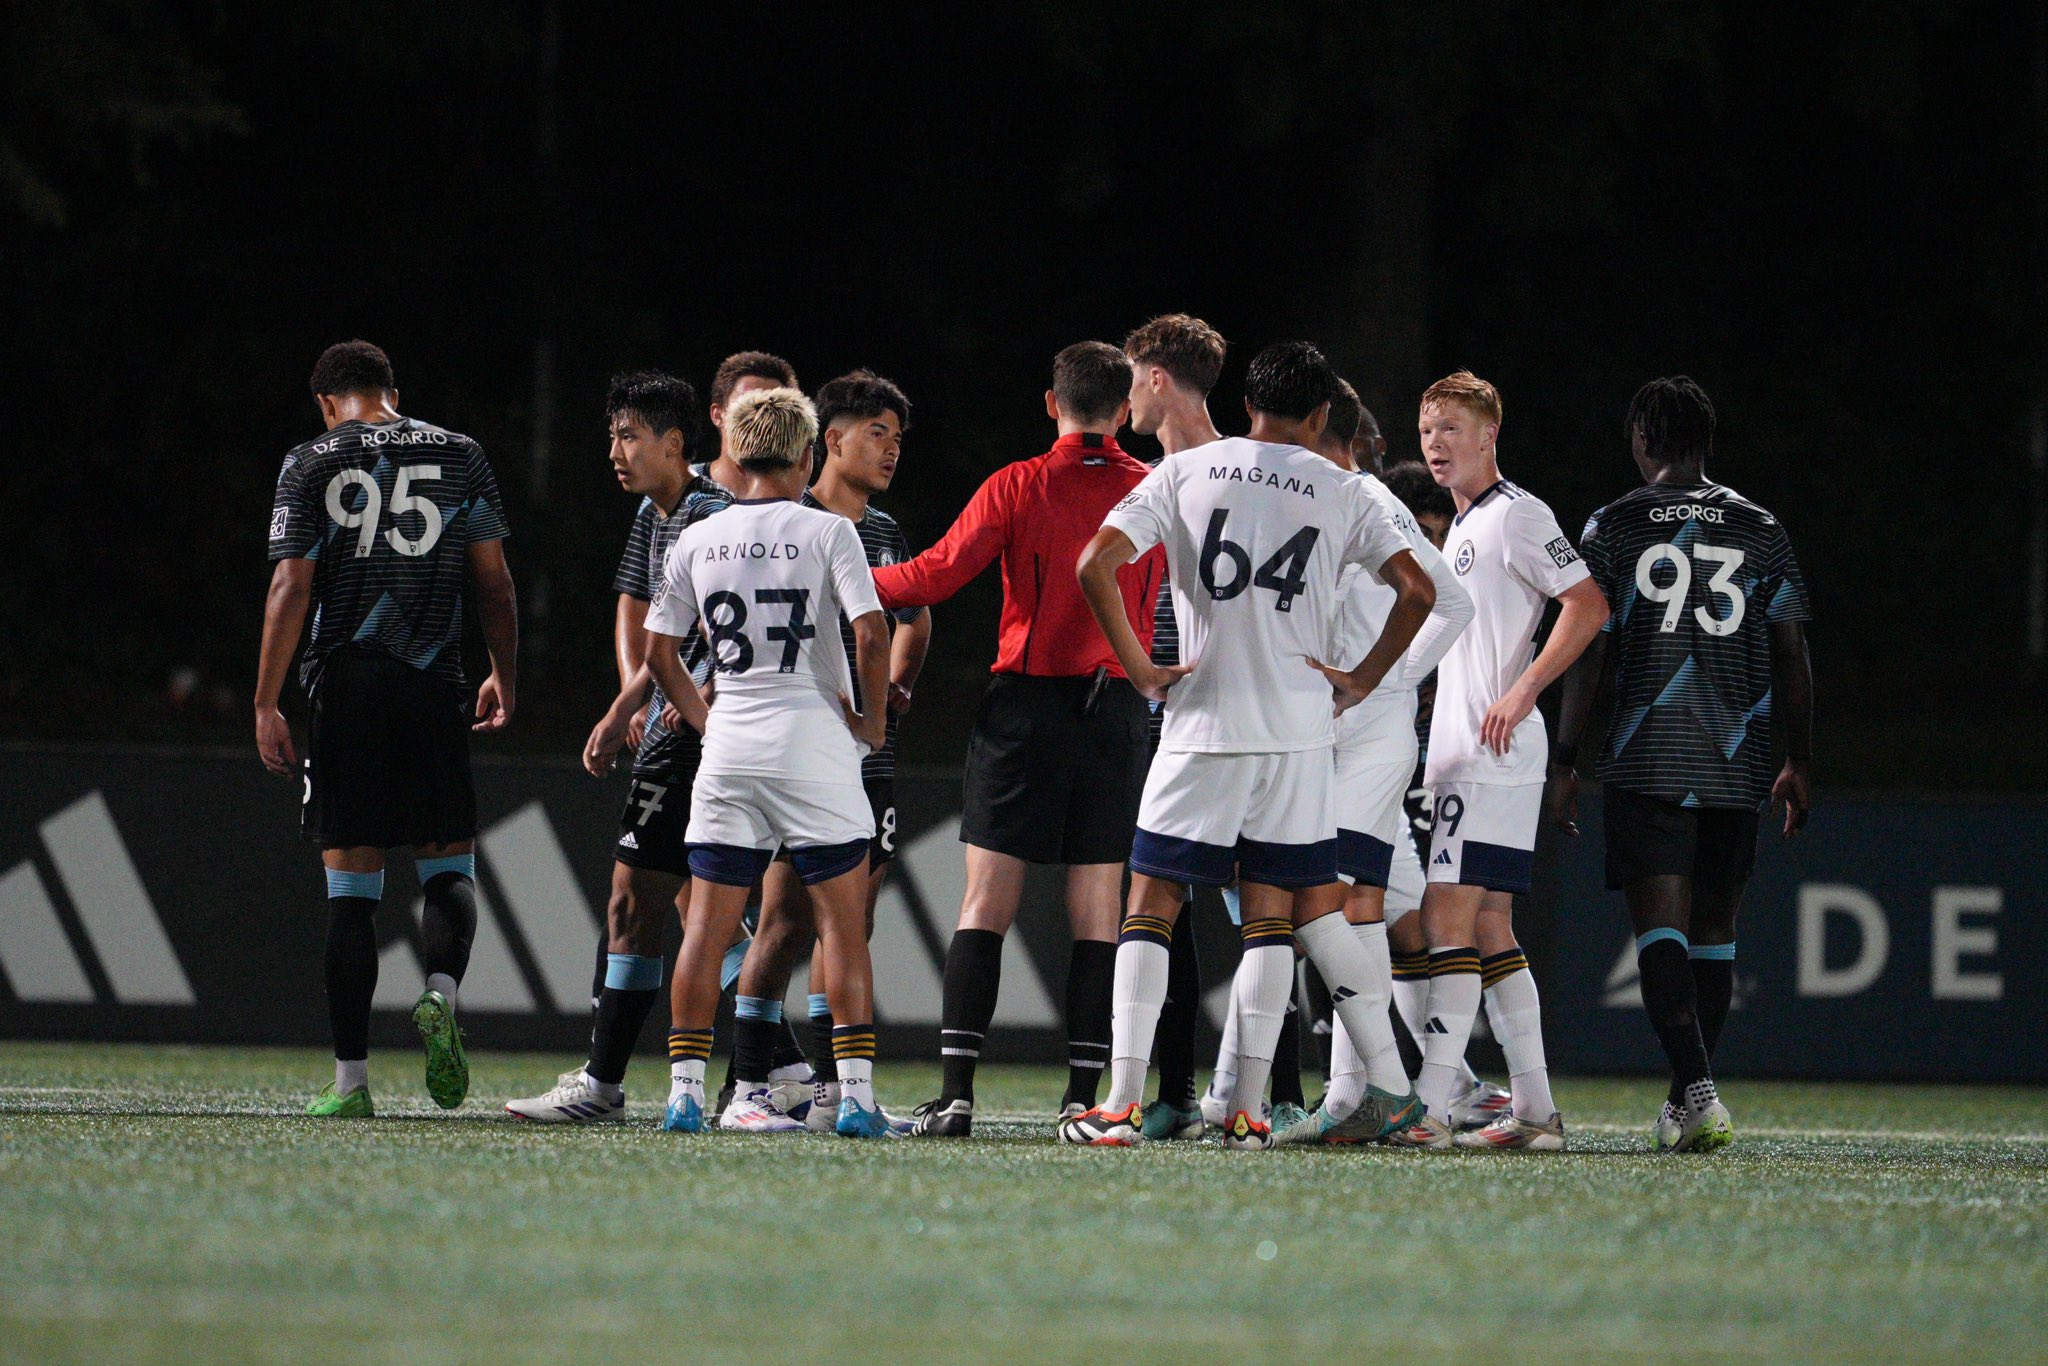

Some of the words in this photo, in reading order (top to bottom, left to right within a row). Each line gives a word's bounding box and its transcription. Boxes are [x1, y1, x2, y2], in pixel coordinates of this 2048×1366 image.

[312, 437, 340, 455] DE
[360, 430, 447, 447] ROSARIO
[325, 465, 443, 558] 95
[1209, 466, 1315, 499] MAGANA
[1649, 504, 1725, 523] GEORGI
[705, 542, 799, 563] ARNOLD
[1199, 508, 1321, 613] 64
[1635, 543, 1746, 636] 93
[703, 588, 815, 675] 87
